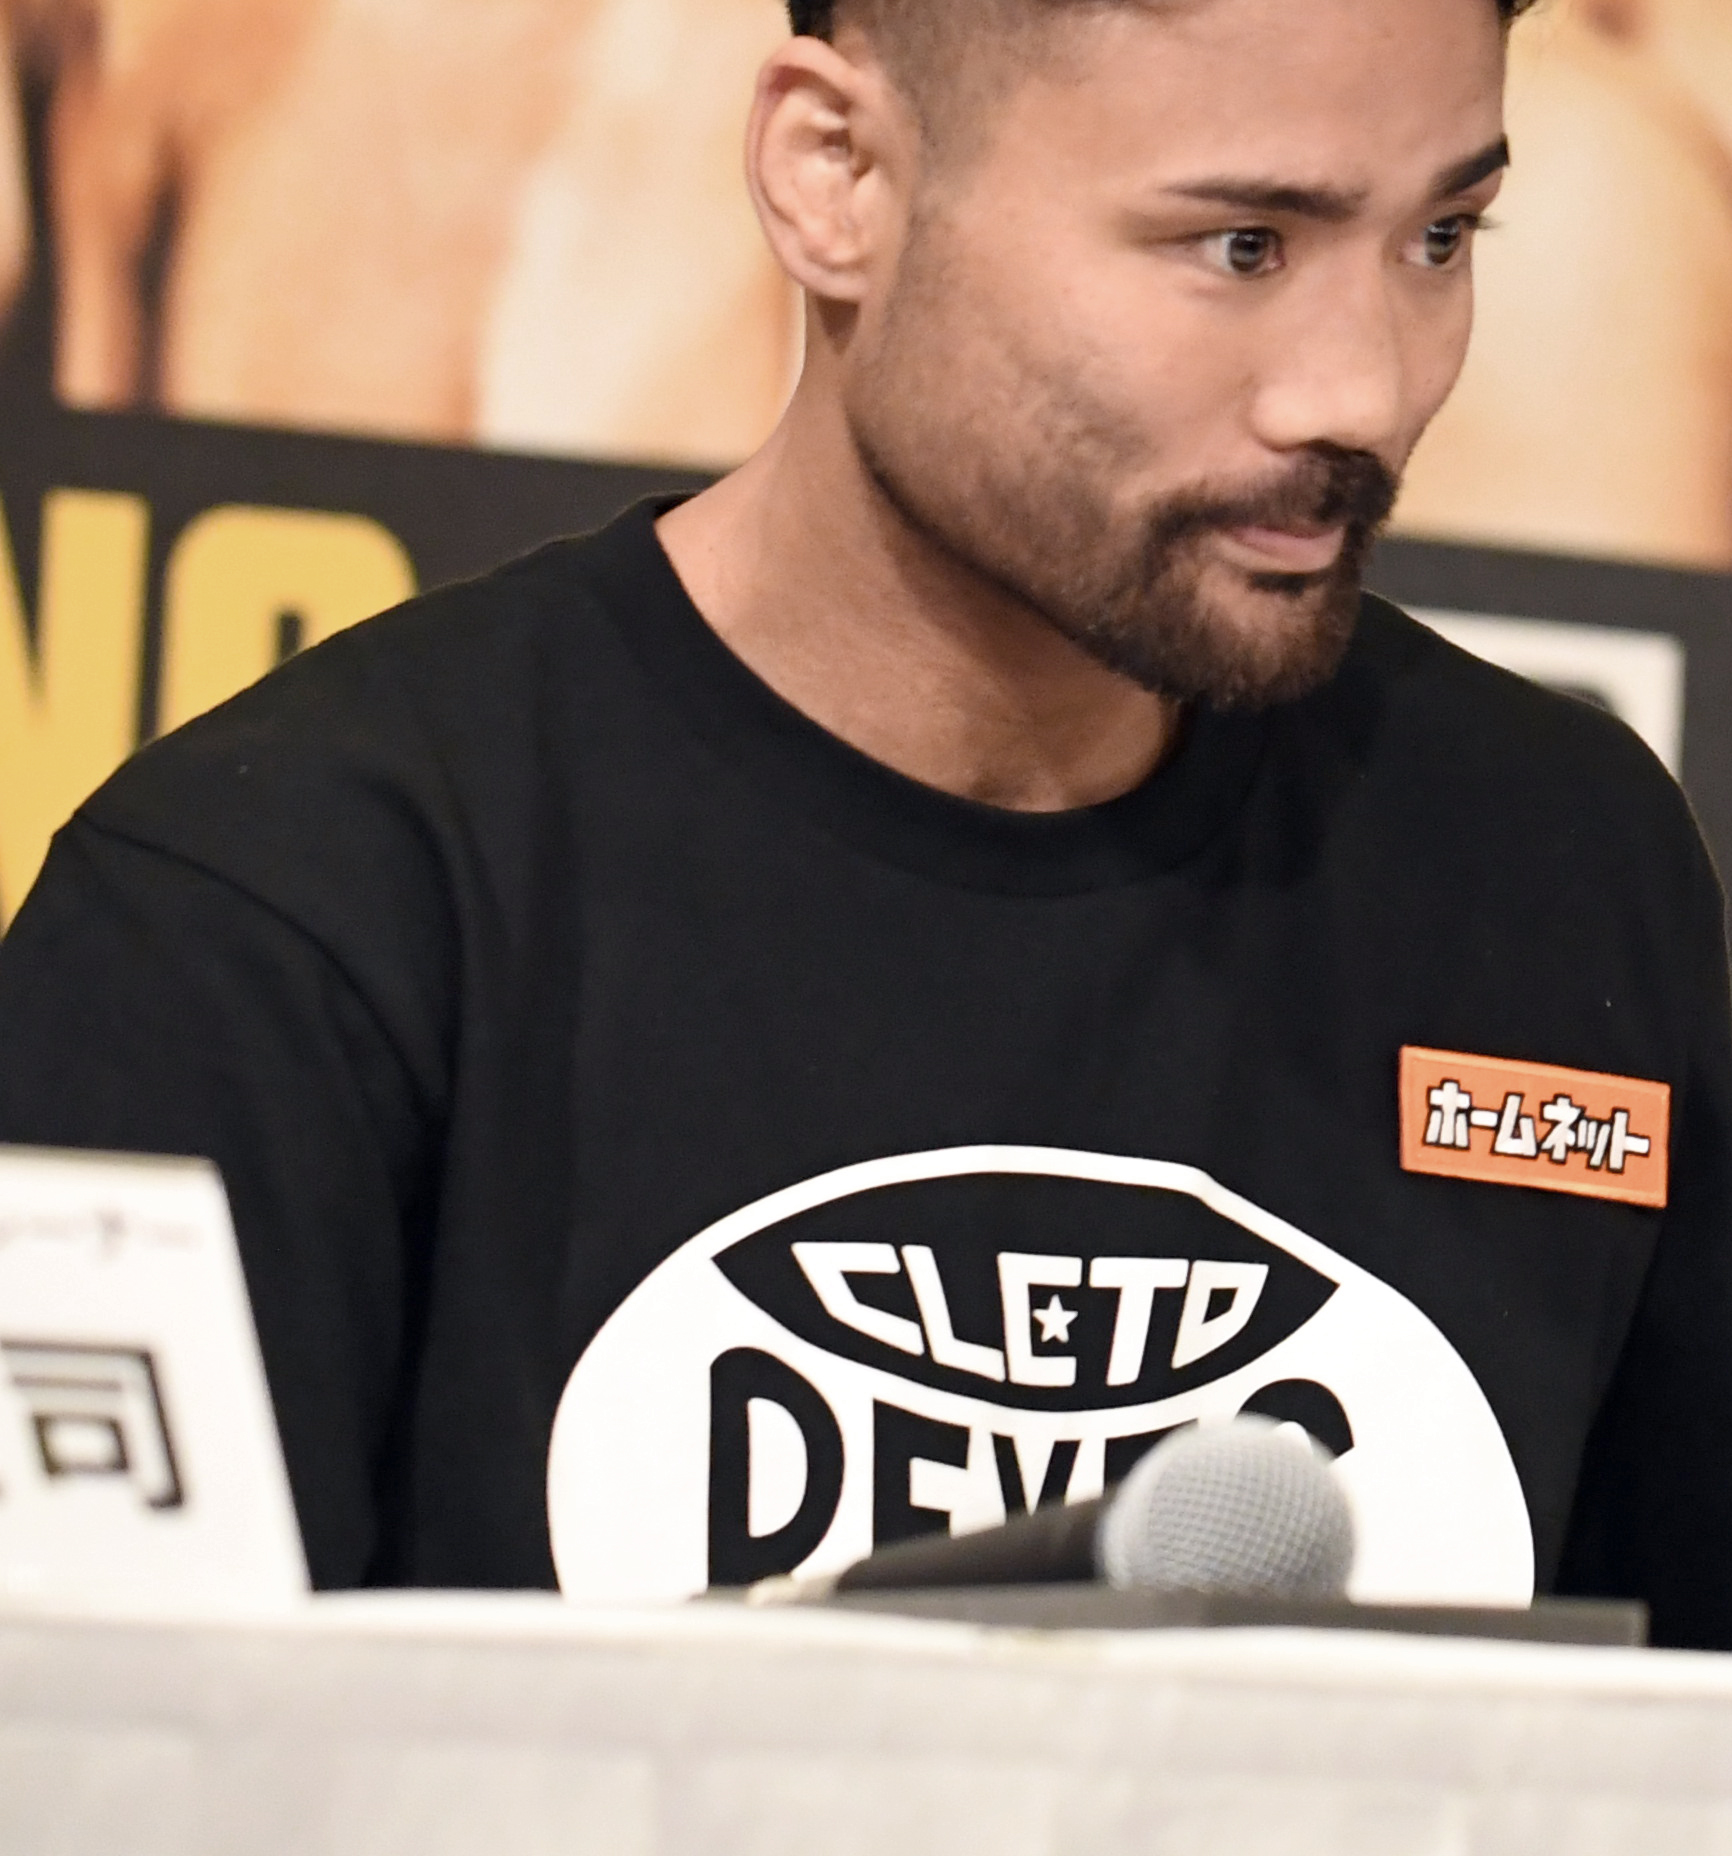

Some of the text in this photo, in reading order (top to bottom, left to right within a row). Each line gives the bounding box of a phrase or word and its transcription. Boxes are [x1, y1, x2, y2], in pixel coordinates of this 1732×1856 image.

[1424, 1079, 1650, 1172] ホームネット
